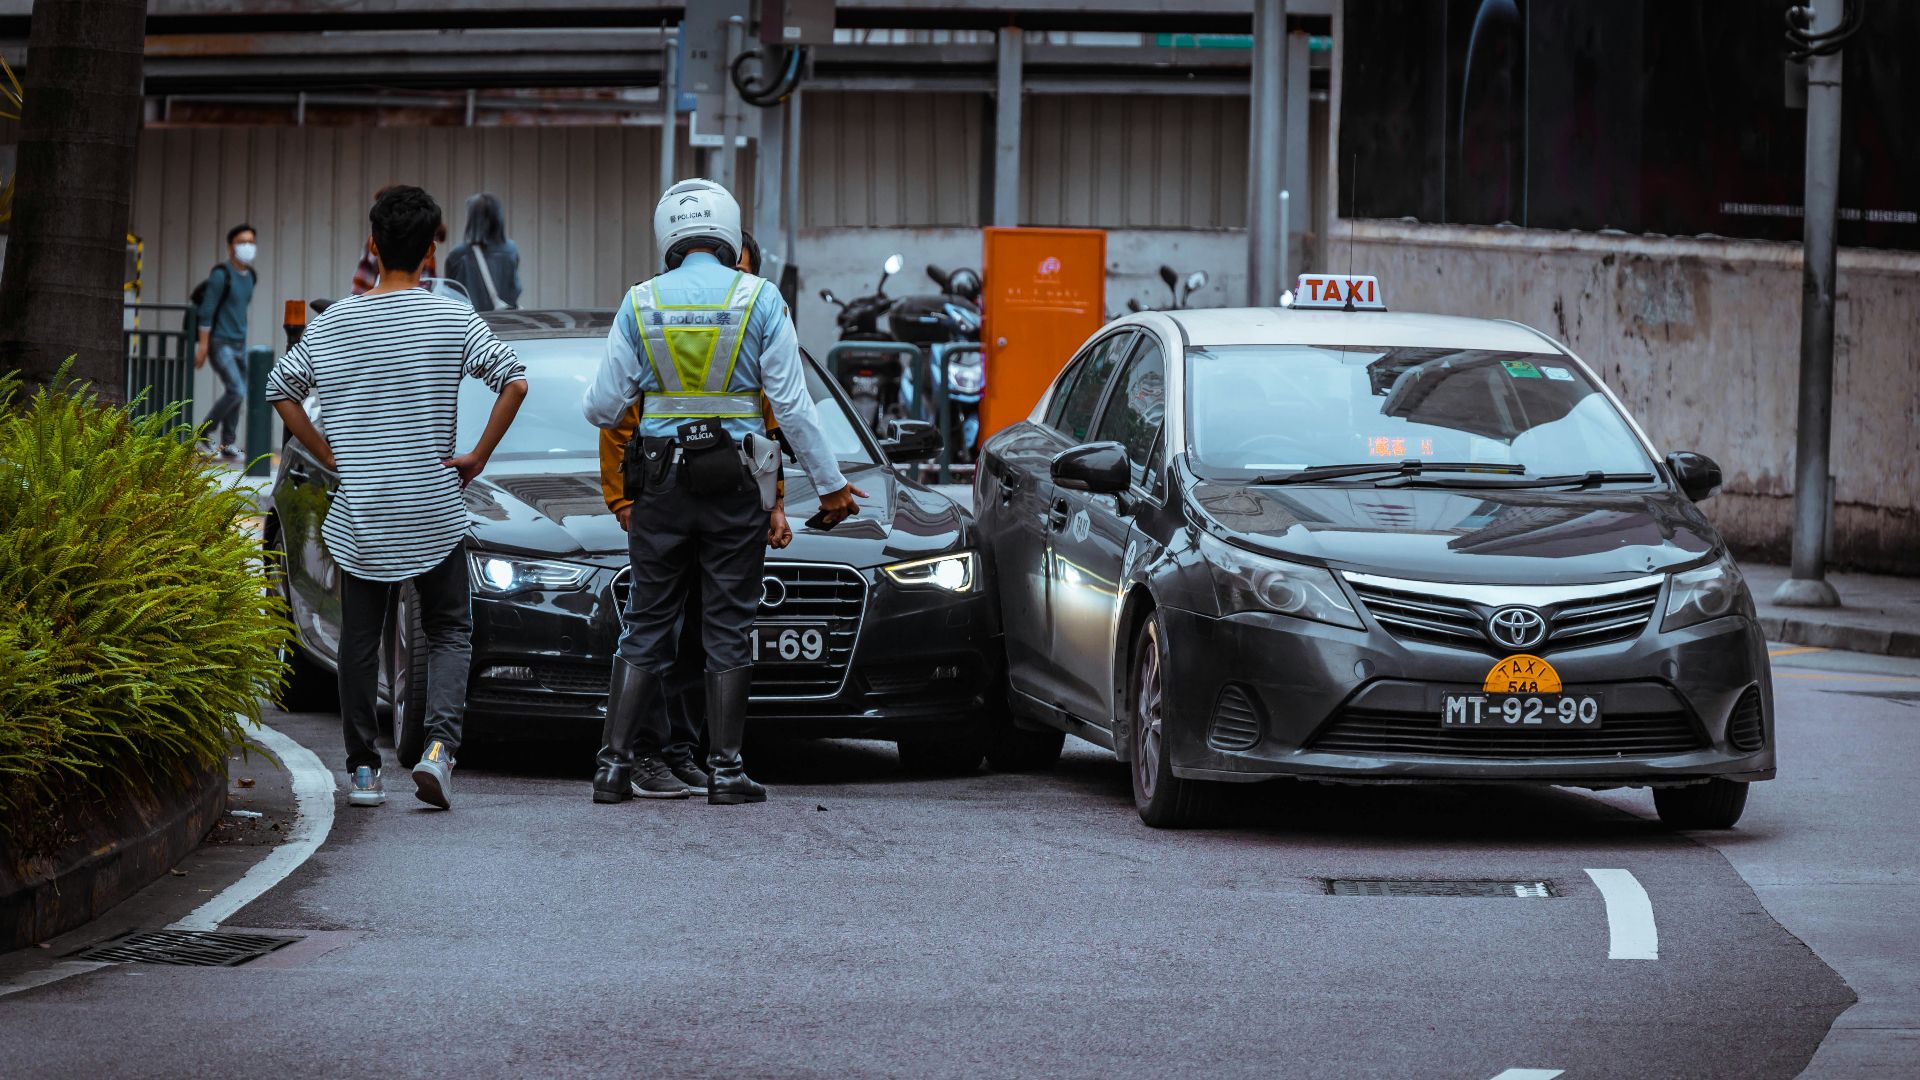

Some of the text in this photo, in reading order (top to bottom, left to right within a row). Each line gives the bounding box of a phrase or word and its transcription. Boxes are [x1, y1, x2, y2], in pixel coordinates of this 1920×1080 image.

[1305, 279, 1374, 302] TAXI
[652, 311, 665, 326] 警
[715, 311, 731, 326] 察
[686, 431, 714, 442] POLÍCIA
[1498, 660, 1546, 679] TAXI
[1508, 681, 1539, 693] 548
[1446, 696, 1598, 724] MT-92-90
